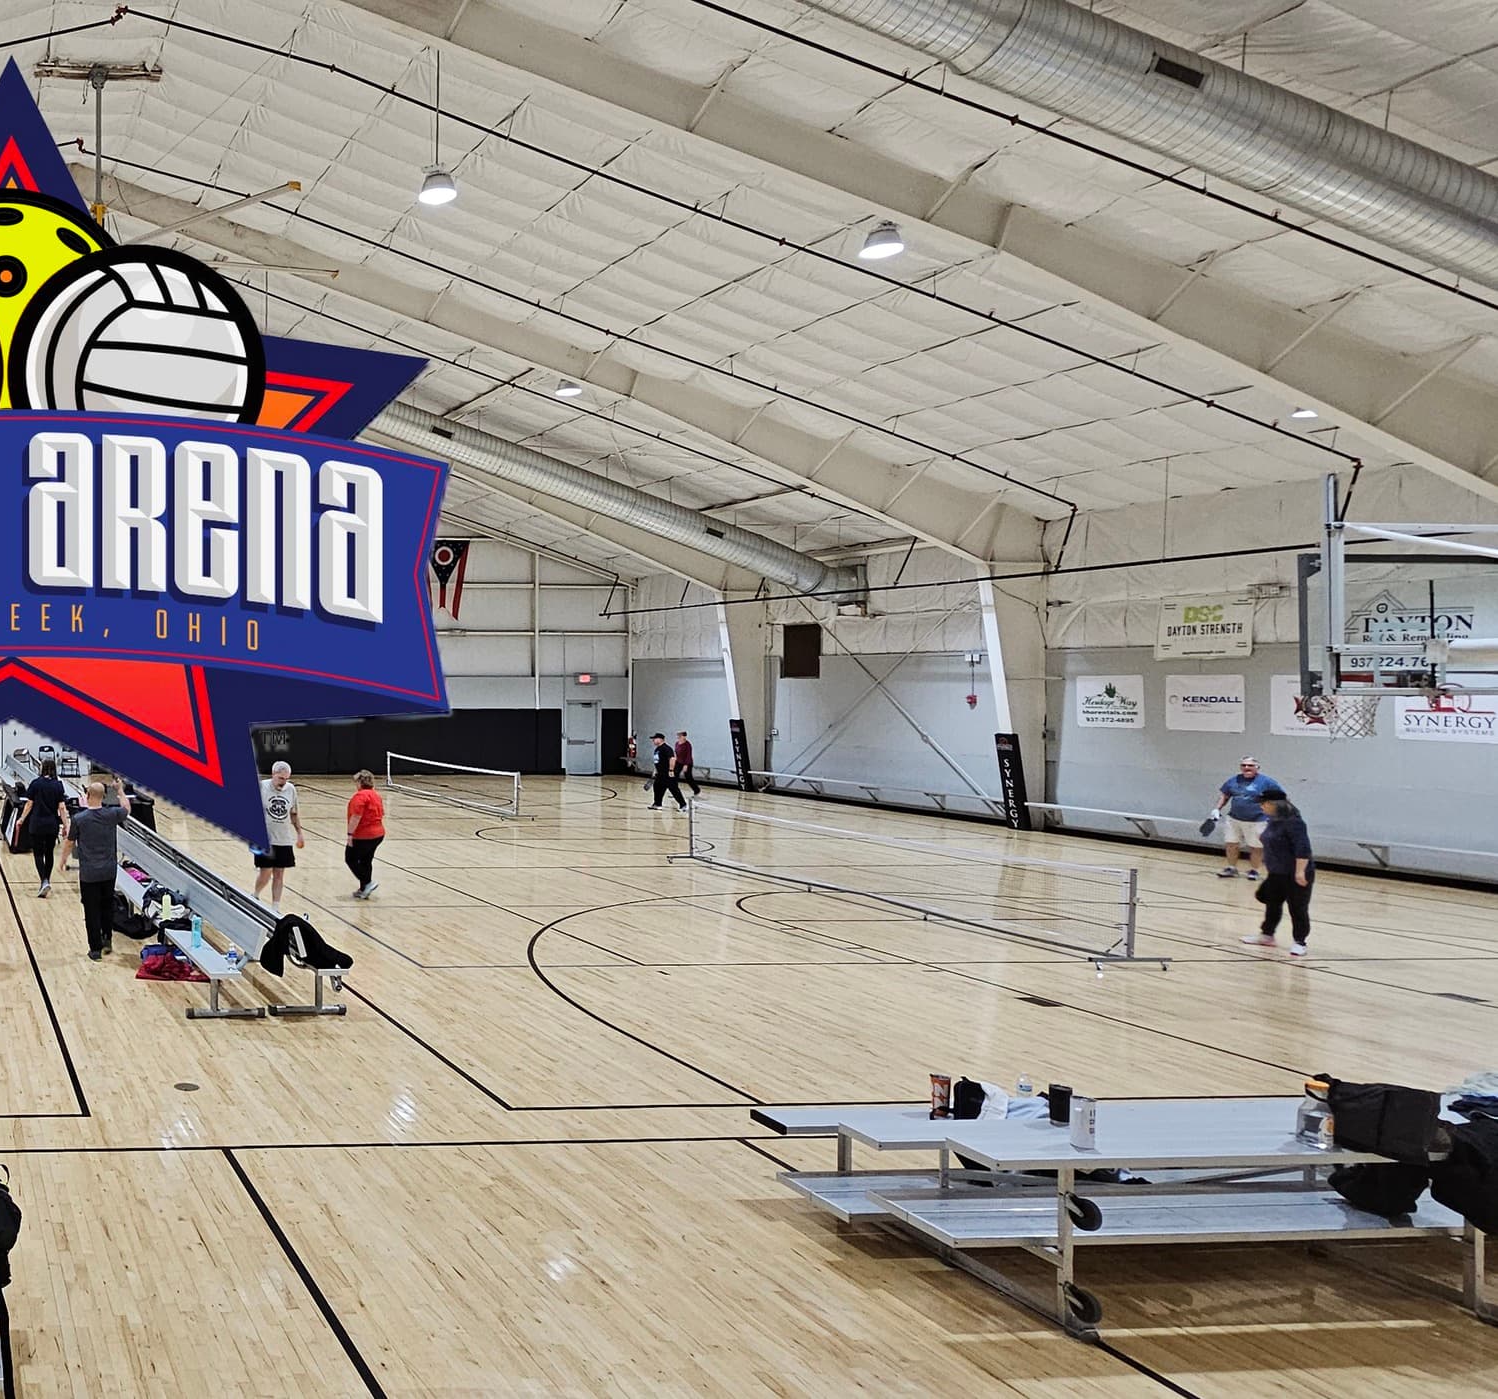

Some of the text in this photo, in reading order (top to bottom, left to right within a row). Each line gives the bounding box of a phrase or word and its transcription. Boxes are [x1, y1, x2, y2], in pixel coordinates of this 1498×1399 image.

[1167, 622, 1243, 637] DAYTON STRENGTH
[1404, 714, 1497, 729] SYNERGY
[1003, 758, 1019, 828] SYNERGY
